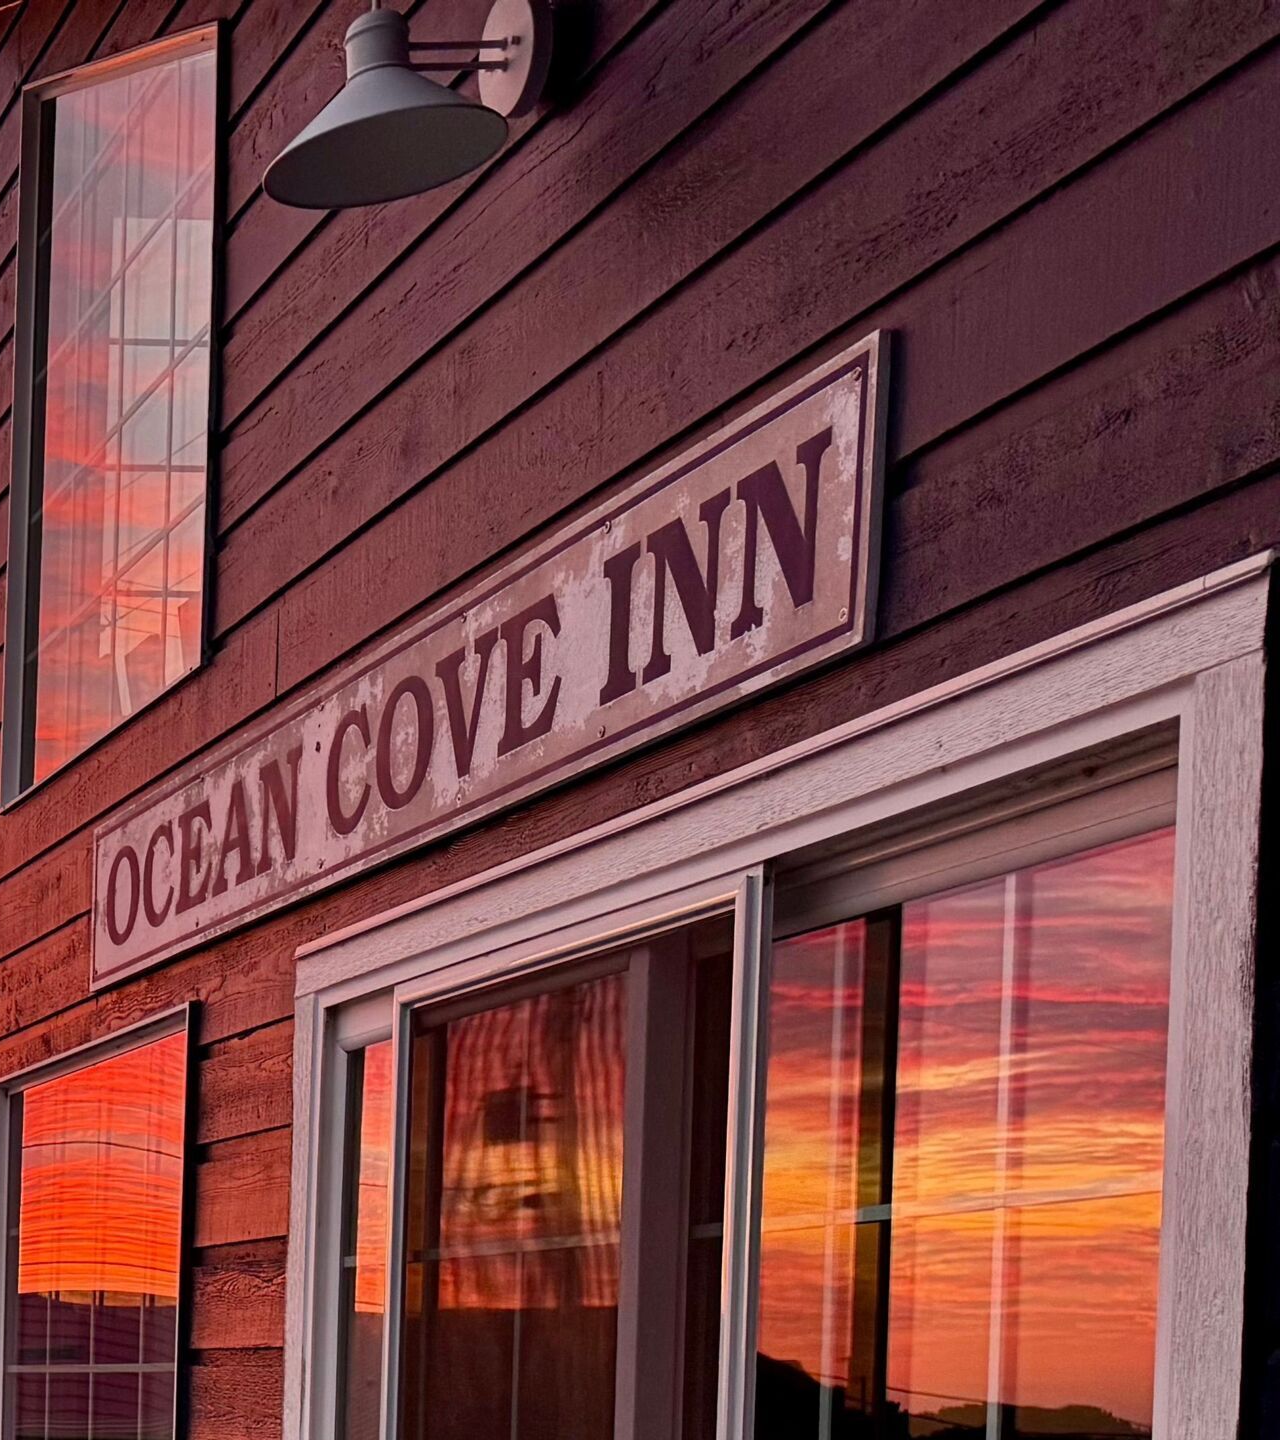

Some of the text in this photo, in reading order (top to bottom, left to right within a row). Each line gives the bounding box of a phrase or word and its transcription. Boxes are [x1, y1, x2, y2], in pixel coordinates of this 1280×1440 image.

[105, 426, 833, 947] OCEAN COVE INN
